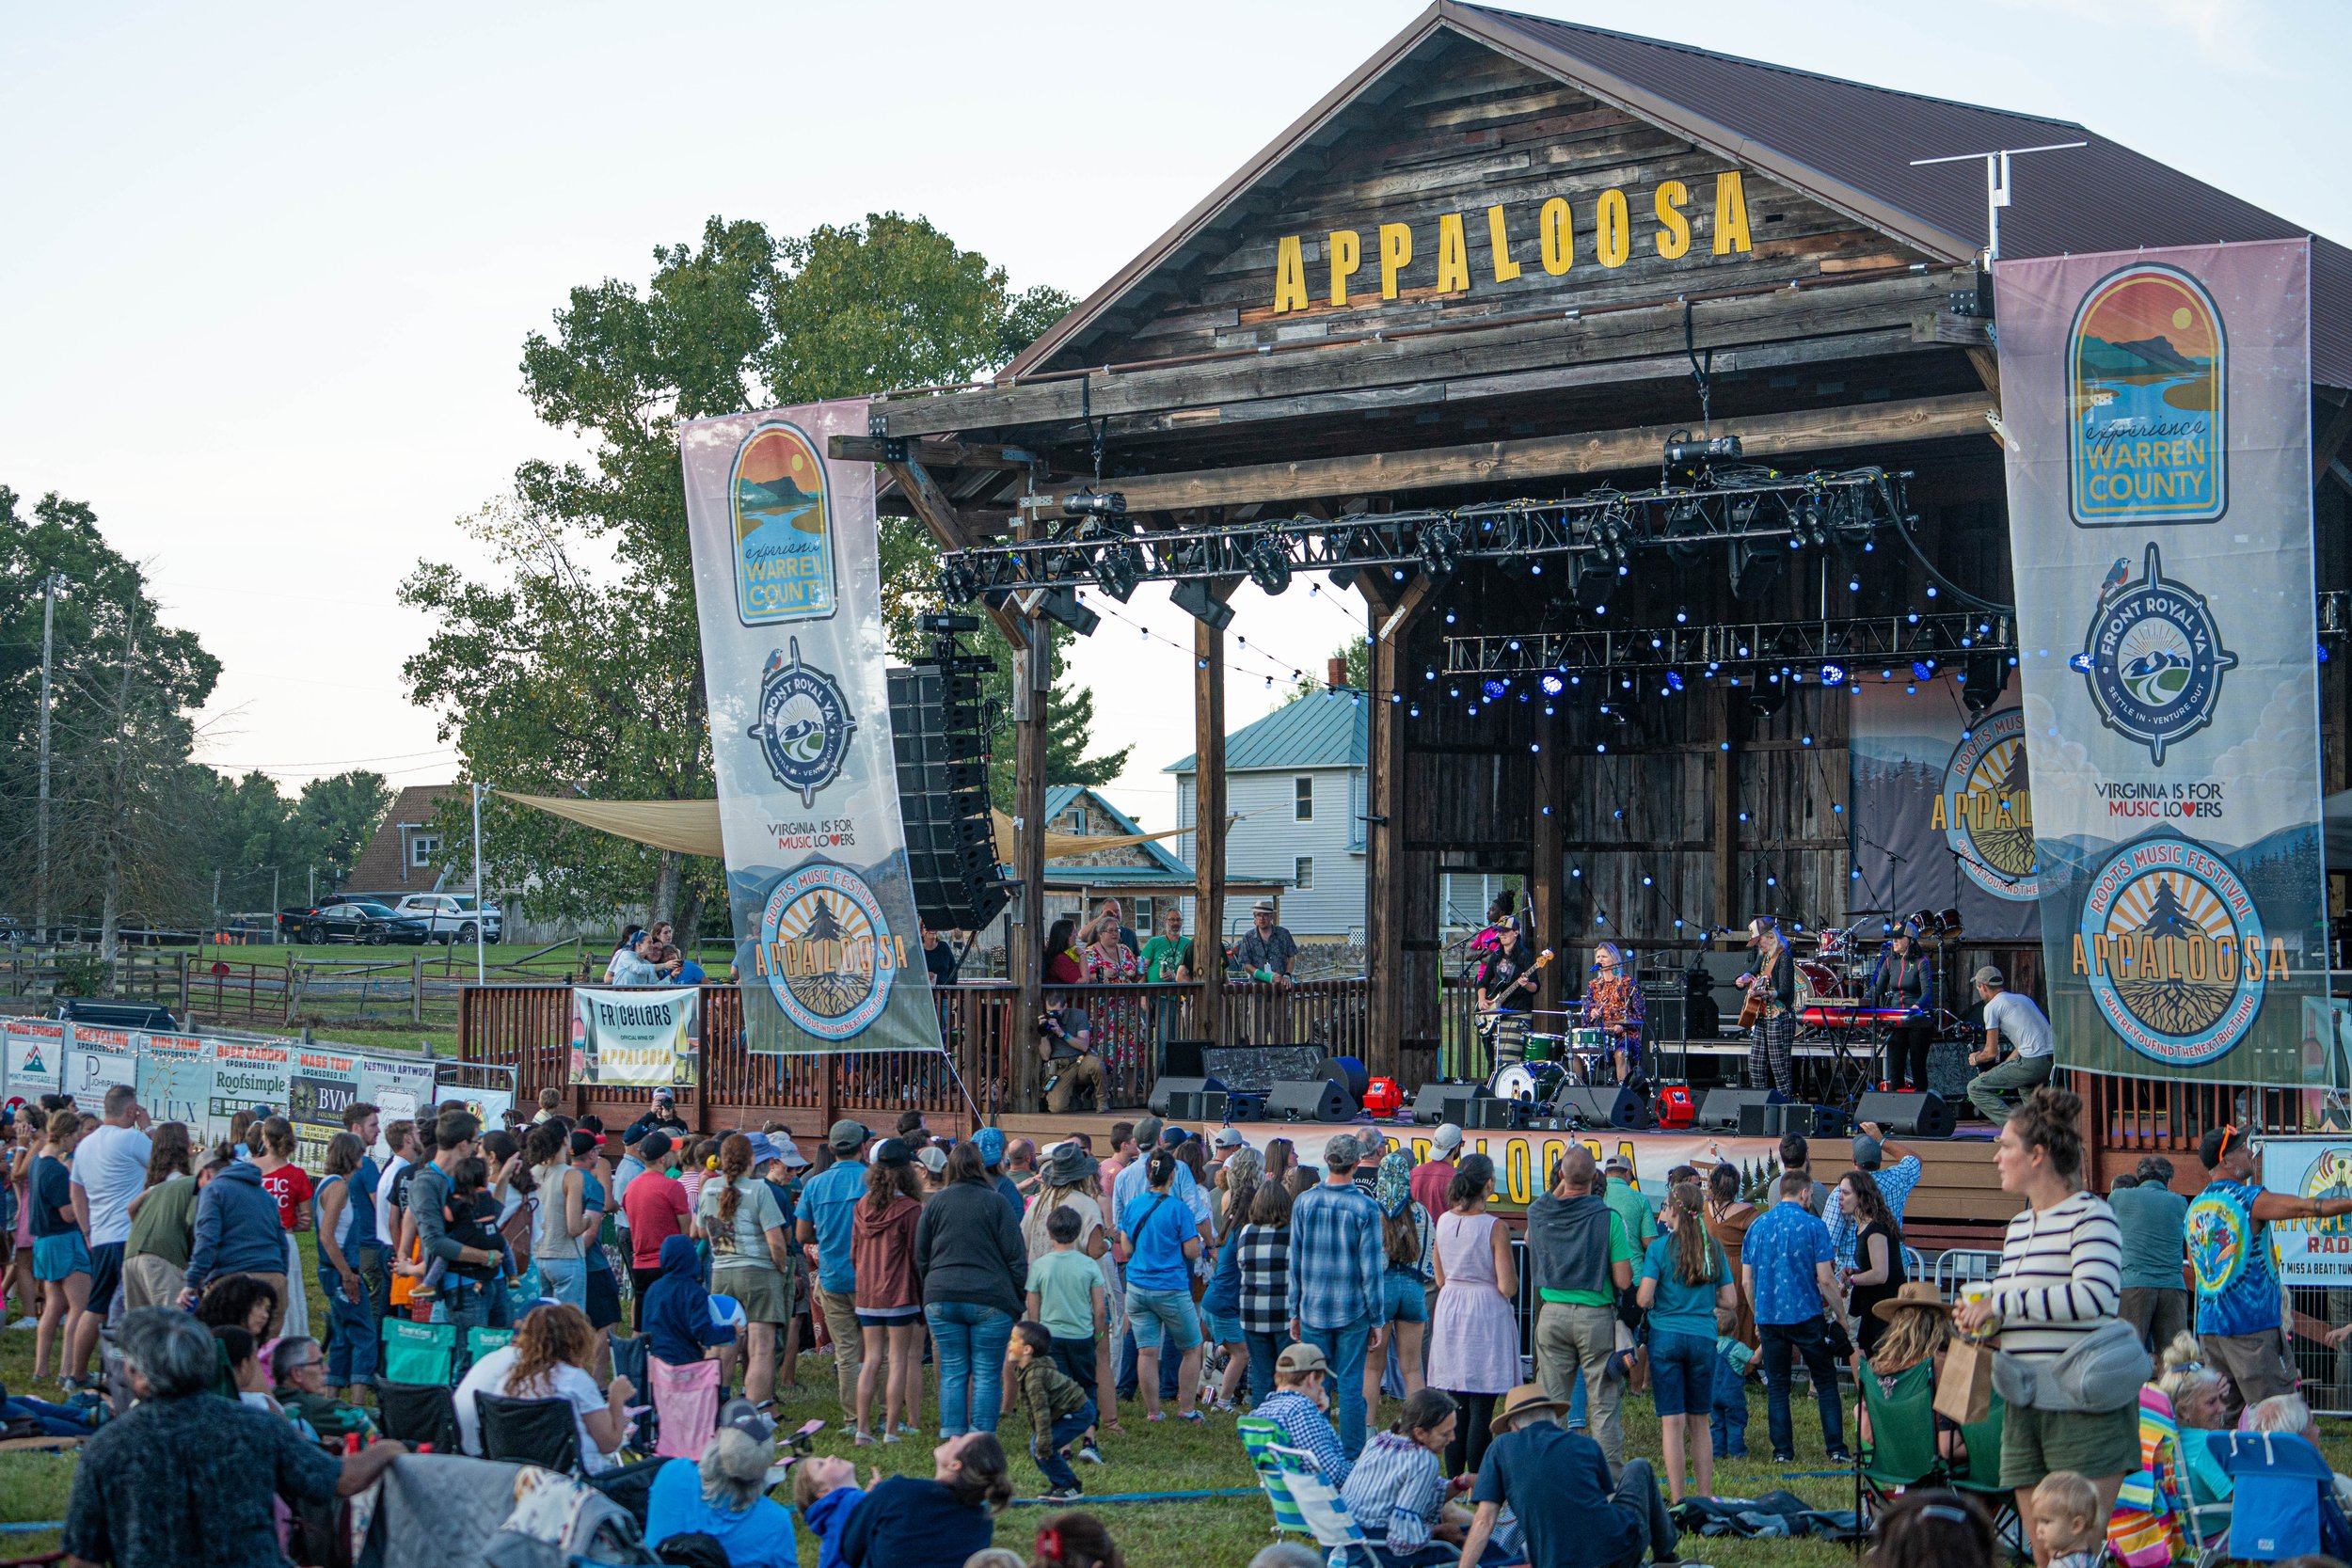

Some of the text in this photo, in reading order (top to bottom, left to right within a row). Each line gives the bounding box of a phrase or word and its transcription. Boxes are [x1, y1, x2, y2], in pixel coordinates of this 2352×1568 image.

[1273, 170, 1753, 313] APPALOOSA
[2086, 415, 2206, 455] experience
[2084, 438, 2206, 470] WARREN
[2089, 469, 2205, 501] COUNTY
[745, 555, 822, 582] WARREN
[2100, 597, 2207, 656] FRONT ROYAL VA
[766, 678, 835, 725] FRONT ROYAL VA
[2107, 683, 2205, 724] SETTLE IN VENTURE OUT
[1953, 714, 2024, 777] ROOTS MUS
[772, 748, 790, 770] SETTLE
[803, 757, 828, 777] VENTURE
[825, 742, 834, 759] OUT
[2094, 783, 2224, 800] VIRGINIA IS FOR
[1931, 790, 2032, 831] APPAL
[2109, 800, 2160, 817] MUSIC
[768, 819, 853, 836] VIRGINIA IS FOR
[778, 835, 812, 849] MUSIC
[2090, 845, 2253, 922] ROOTS MUSIC FESTIVAL
[765, 869, 882, 927] ROOTS MUSIC FESTIVAL
[755, 934, 909, 976] APPALOOSA
[2072, 932, 2290, 982] APPALOOSA
[7, 1023, 30, 1035] PROUD
[31, 1024, 63, 1037] SPONSOR
[74, 1027, 129, 1046] RECYCLING
[77, 1042, 116, 1053] SPONSORED
[151, 1036, 200, 1052] KIDS ZONE
[216, 1044, 287, 1063] BEER GARDEN
[151, 1049, 187, 1059] SPONSORED
[300, 1053, 354, 1071] MASS TENT
[600, 1048, 672, 1066] APPALOOSA
[226, 1059, 278, 1071] SPONSORED BY:
[363, 1061, 433, 1078] FESTIVAL ARTWORK
[216, 1071, 285, 1095] Roofsimple
[302, 1069, 350, 1081] SPONSORED BY:
[224, 1101, 236, 1110] WE
[237, 1101, 248, 1110] DO
[318, 1087, 355, 1112] BVM
[152, 1099, 197, 1123] LUX
[317, 1111, 343, 1120] FOUNDAT
[2307, 1236, 2350, 1253] RAD
[2287, 1262, 2305, 1274] MISS
[2307, 1262, 2312, 1274] A
[2313, 1262, 2336, 1275] BEAT!
[2338, 1262, 2352, 1275] TUN
